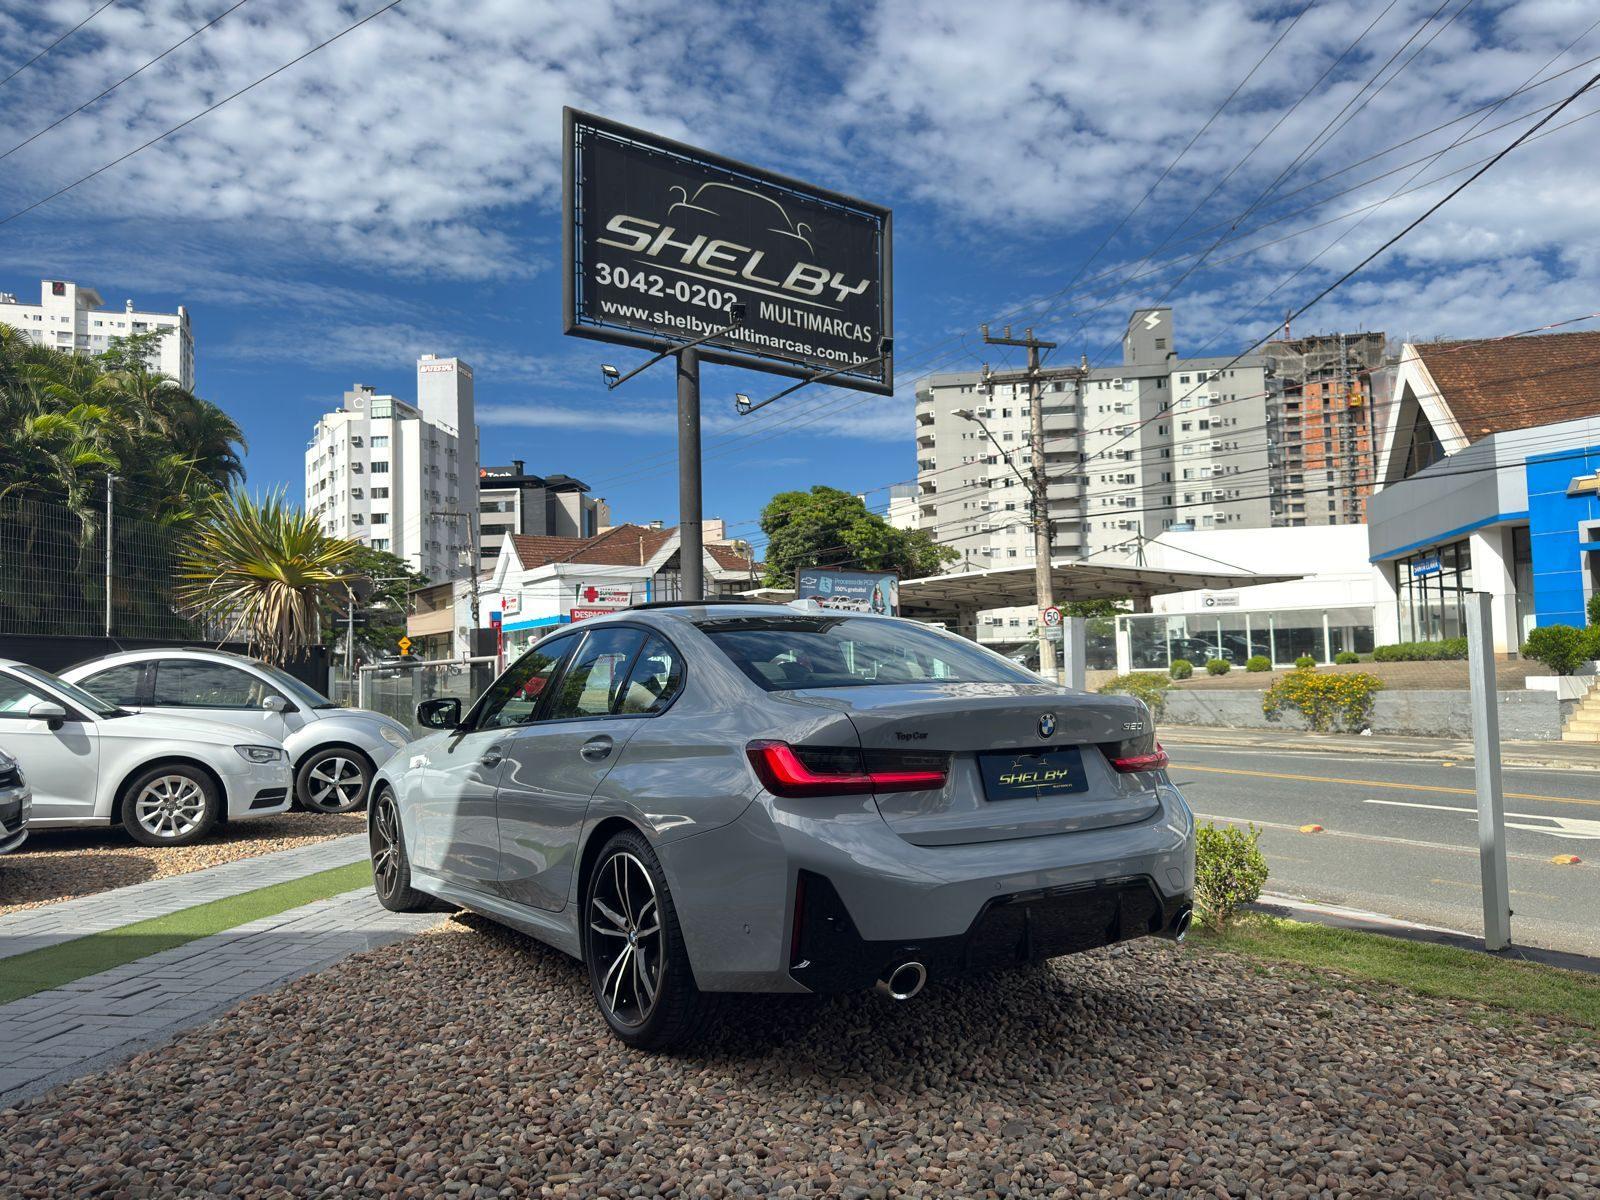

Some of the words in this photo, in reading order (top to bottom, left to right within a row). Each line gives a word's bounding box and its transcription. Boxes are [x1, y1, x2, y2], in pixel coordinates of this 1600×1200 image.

[596, 214, 870, 302] SHELBY
[595, 263, 737, 312] 3042-0202
[601, 301, 868, 364] www.shelbymultimarcas.com.br
[760, 301, 872, 343] MULTIMARCAS
[1046, 611, 1058, 621] 50
[998, 769, 1068, 785] SHELBY
